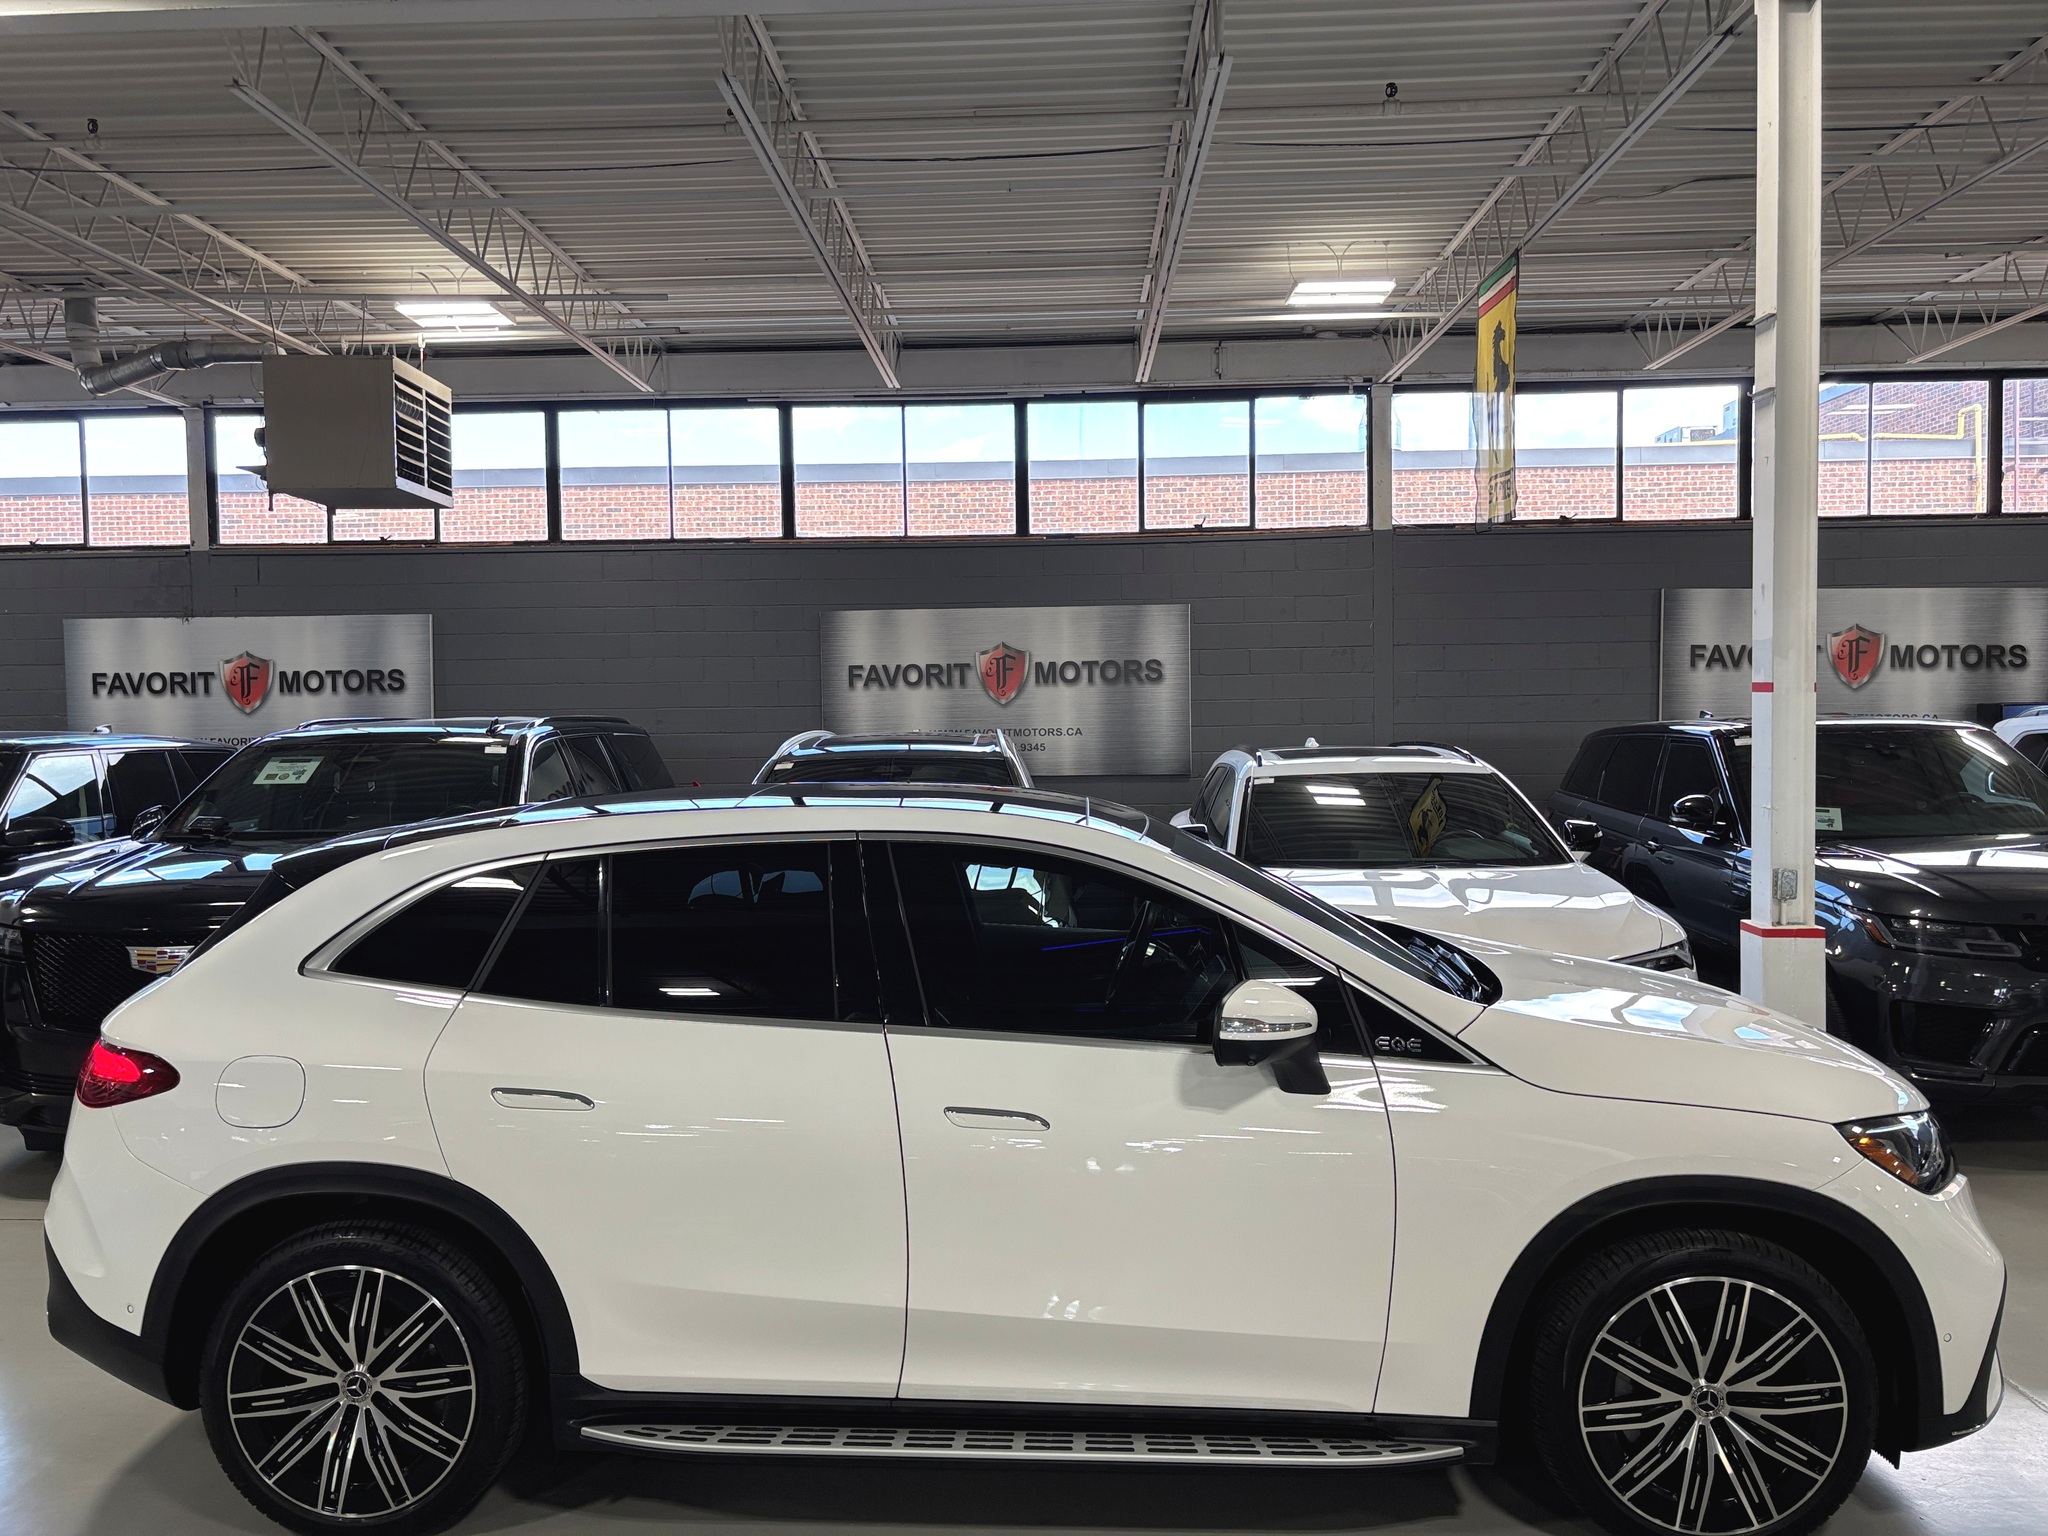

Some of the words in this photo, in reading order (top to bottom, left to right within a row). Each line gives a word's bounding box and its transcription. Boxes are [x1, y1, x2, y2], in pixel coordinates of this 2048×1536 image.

[1890, 644, 2028, 668] MOTORS
[92, 671, 215, 695] FAVORIT
[279, 669, 405, 693] MOTORS
[848, 663, 971, 687] FAVORIT
[1034, 658, 1163, 684] MOTORS
[1375, 1036, 1422, 1052] EQE
